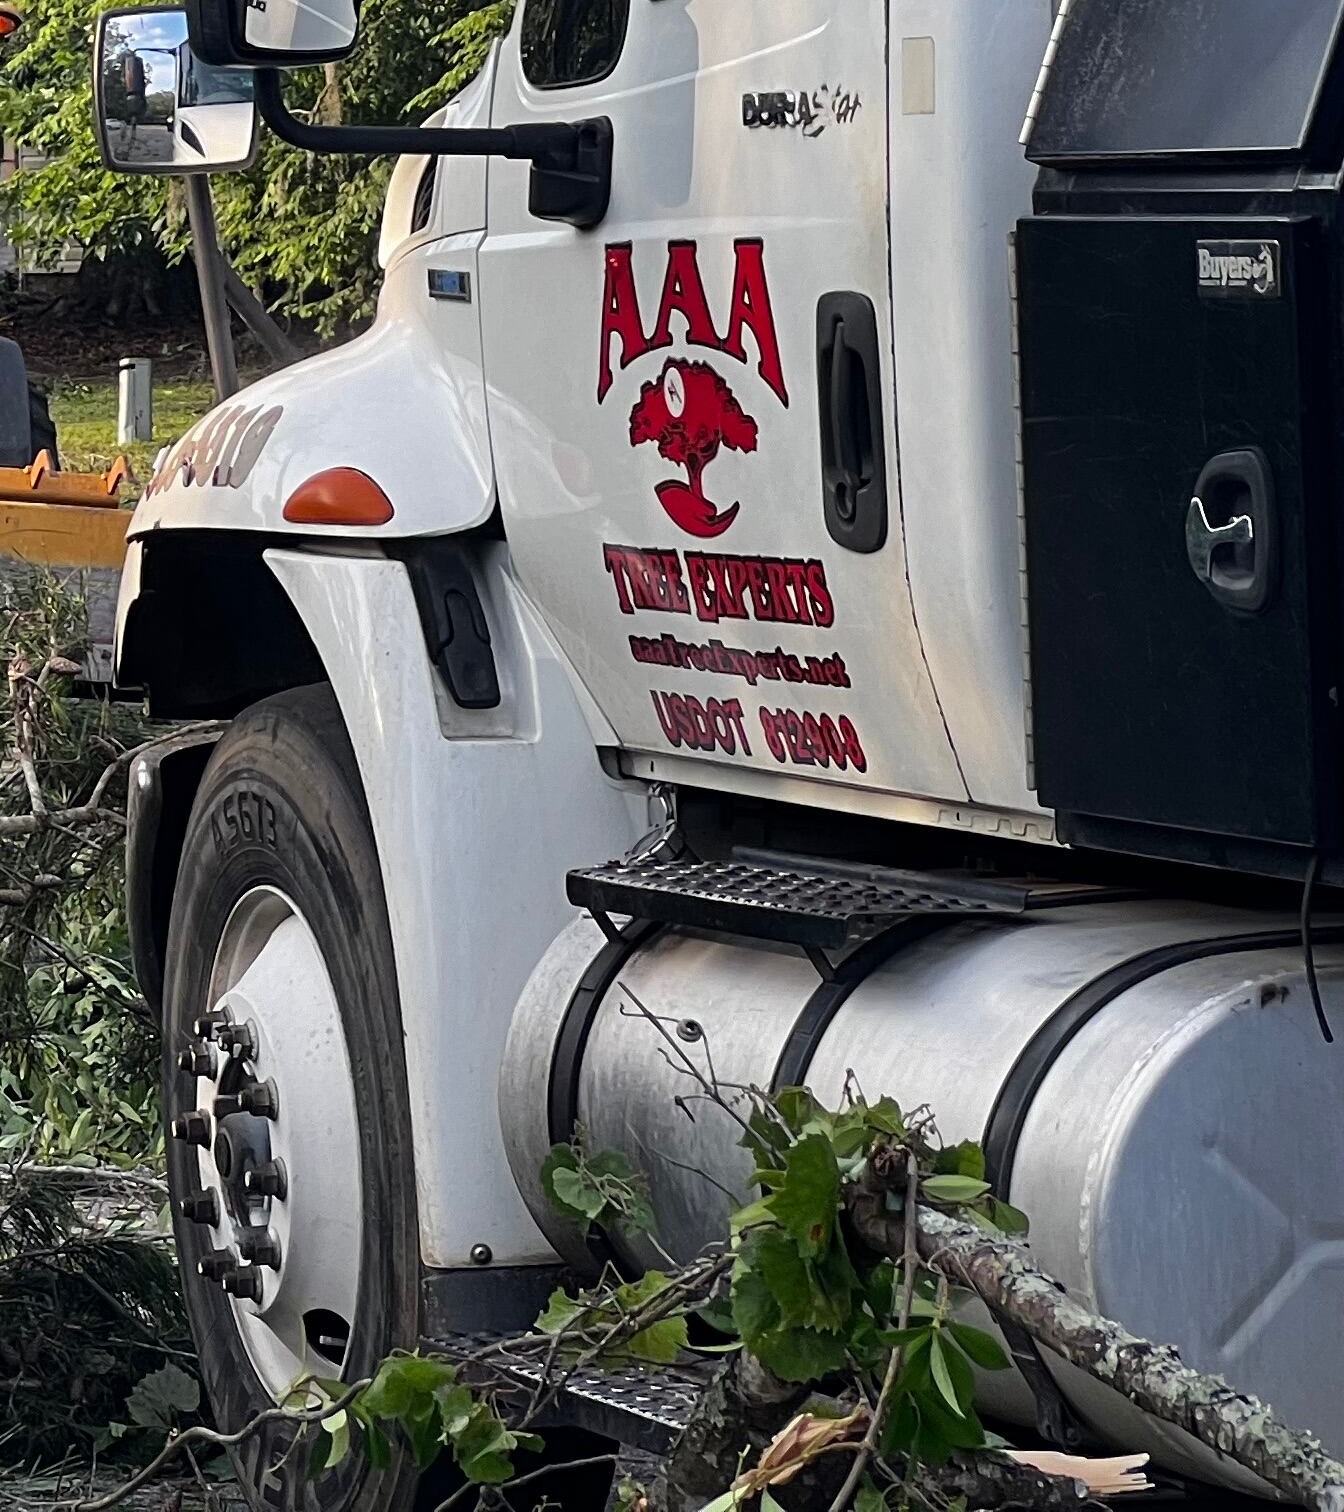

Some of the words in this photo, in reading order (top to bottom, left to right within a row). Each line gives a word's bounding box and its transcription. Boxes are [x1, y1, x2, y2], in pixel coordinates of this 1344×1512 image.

[1198, 249, 1252, 286] Buyers
[598, 237, 789, 409] AAA
[603, 543, 691, 615] TREE
[684, 551, 835, 628] EXPERTS
[649, 690, 753, 757] USDOT
[759, 705, 867, 774] 812908
